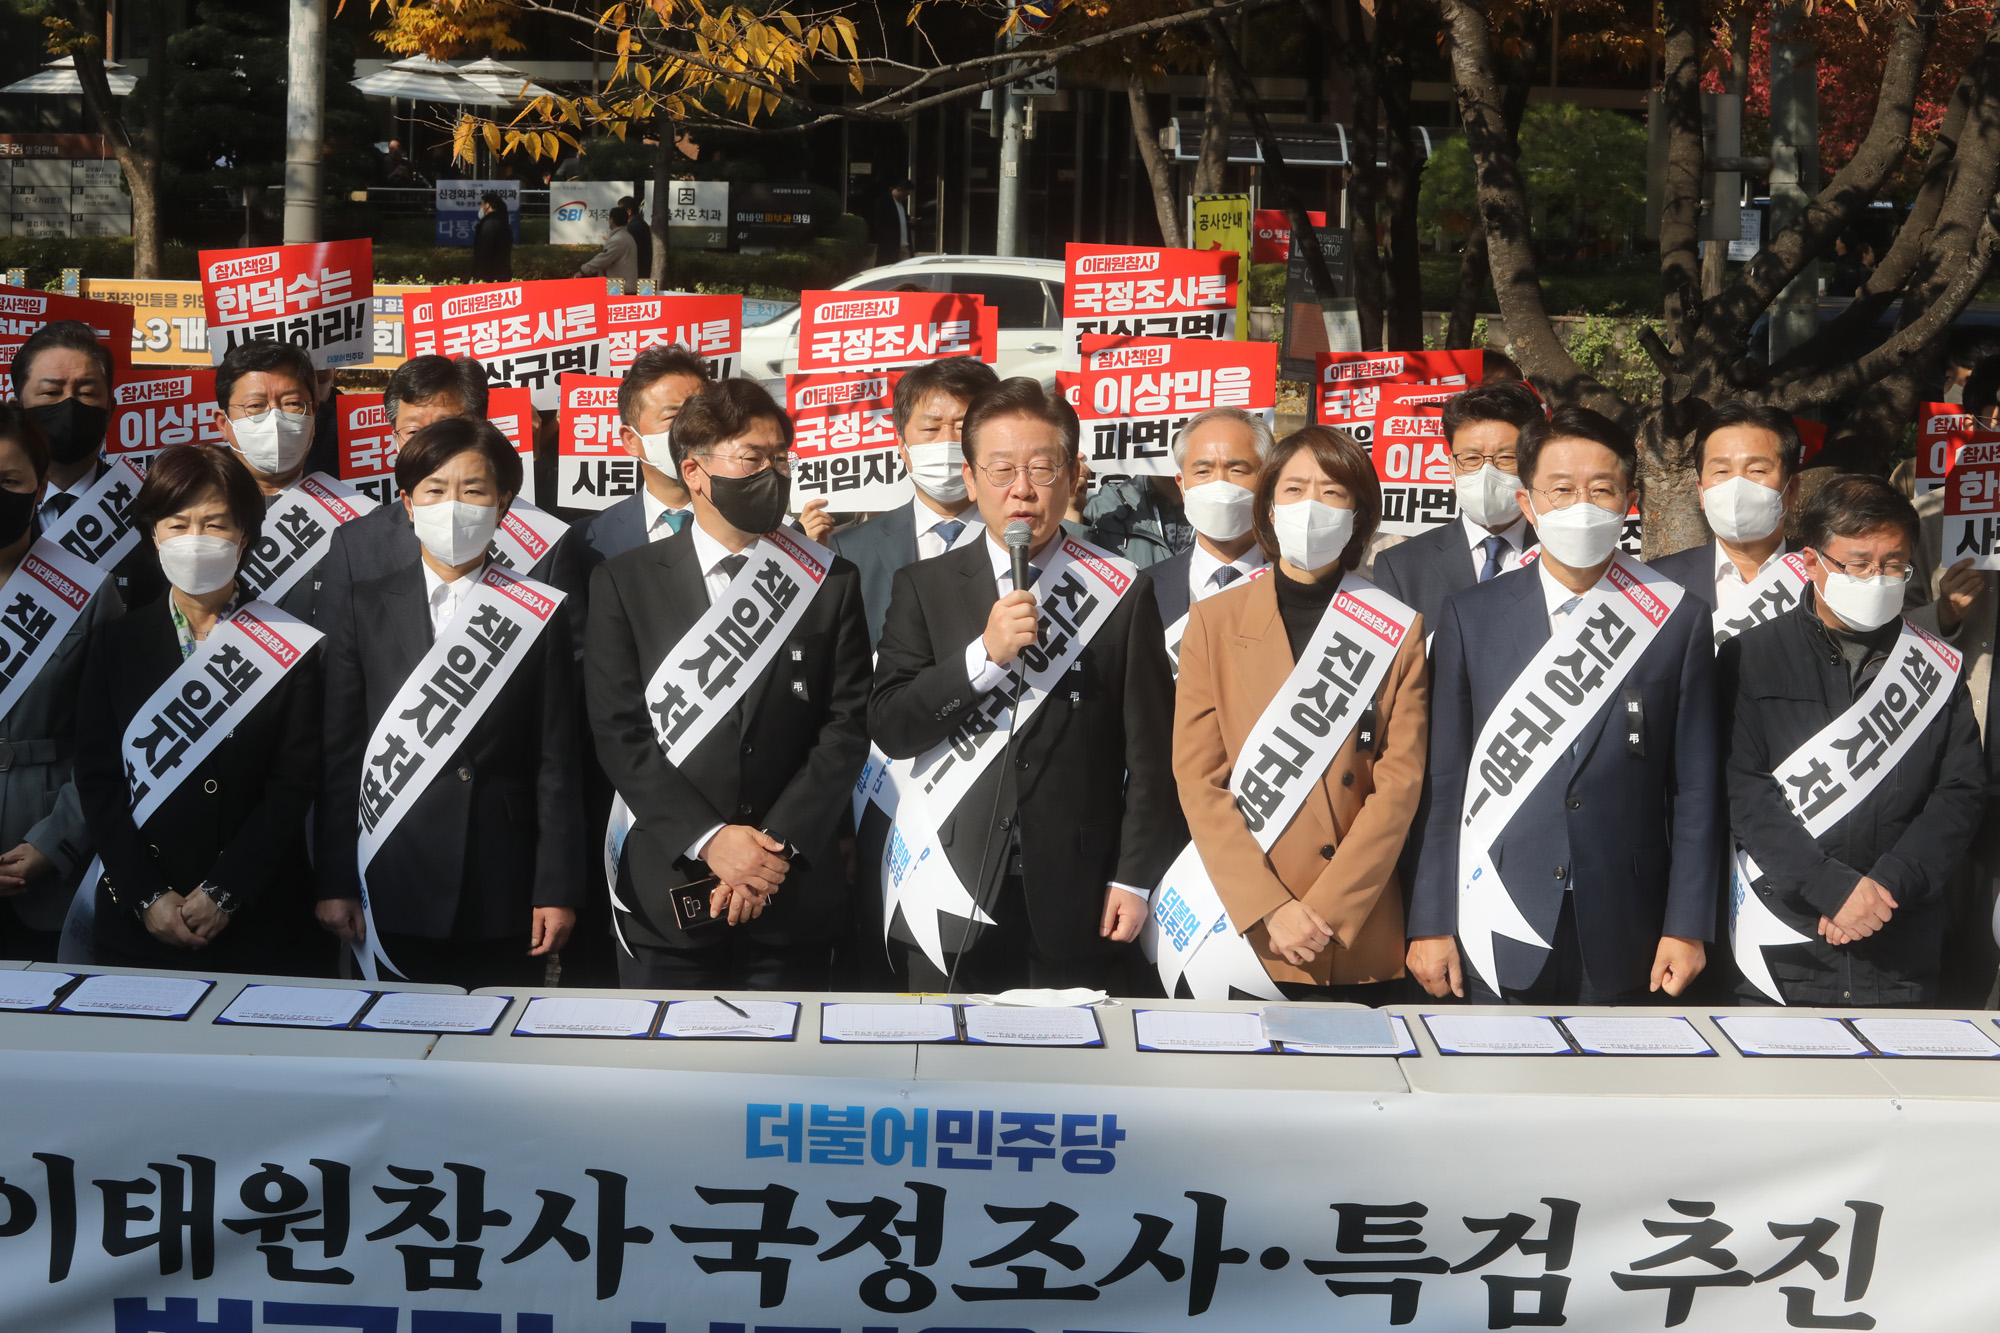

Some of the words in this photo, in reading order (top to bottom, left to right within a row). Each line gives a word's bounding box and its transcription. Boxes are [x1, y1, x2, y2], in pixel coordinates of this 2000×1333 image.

[557, 208, 583, 222] SBI
[707, 232, 721, 243] 2F
[1199, 211, 1243, 231] 공사안내
[215, 256, 273, 280] 참사책임
[1083, 255, 1155, 273] 이태원참사
[1323, 244, 1341, 256] STOP
[215, 268, 352, 323] 한덕수는
[448, 291, 518, 316] 이태원참사
[821, 300, 895, 321] 이태원참사
[1074, 275, 1227, 313] 국정조사로
[443, 303, 597, 358] 국정조사로
[812, 320, 970, 363] 국정조사로
[1098, 348, 1163, 368] 참사책임
[1331, 360, 1400, 380] 이태원참사
[121, 380, 185, 403] 참사책임
[803, 380, 883, 406] 이태원참사
[1095, 366, 1251, 415] 이상민을
[768, 531, 823, 577] 이태원참사
[1066, 544, 1126, 590] 이태원참사
[26, 554, 84, 605] 이태원참사
[487, 572, 550, 614] 이태원참사
[1610, 567, 1665, 622] 이태원참사
[237, 614, 294, 662] 이태원참사
[678, 558, 800, 700] 책임자
[1337, 595, 1400, 642] 이태원참사
[398, 603, 522, 748] 책임자
[1544, 602, 1637, 707] 진상
[1290, 630, 1376, 738] 진상
[131, 643, 263, 779] 책임자
[1830, 644, 1943, 782] 책임자
[1464, 691, 1567, 827] 규명!
[1162, 887, 1201, 938] 더불어
[745, 1103, 1126, 1175] 더불어민주당
[0, 1151, 655, 1301] 이태원참사
[1610, 1197, 1885, 1331] 추진
